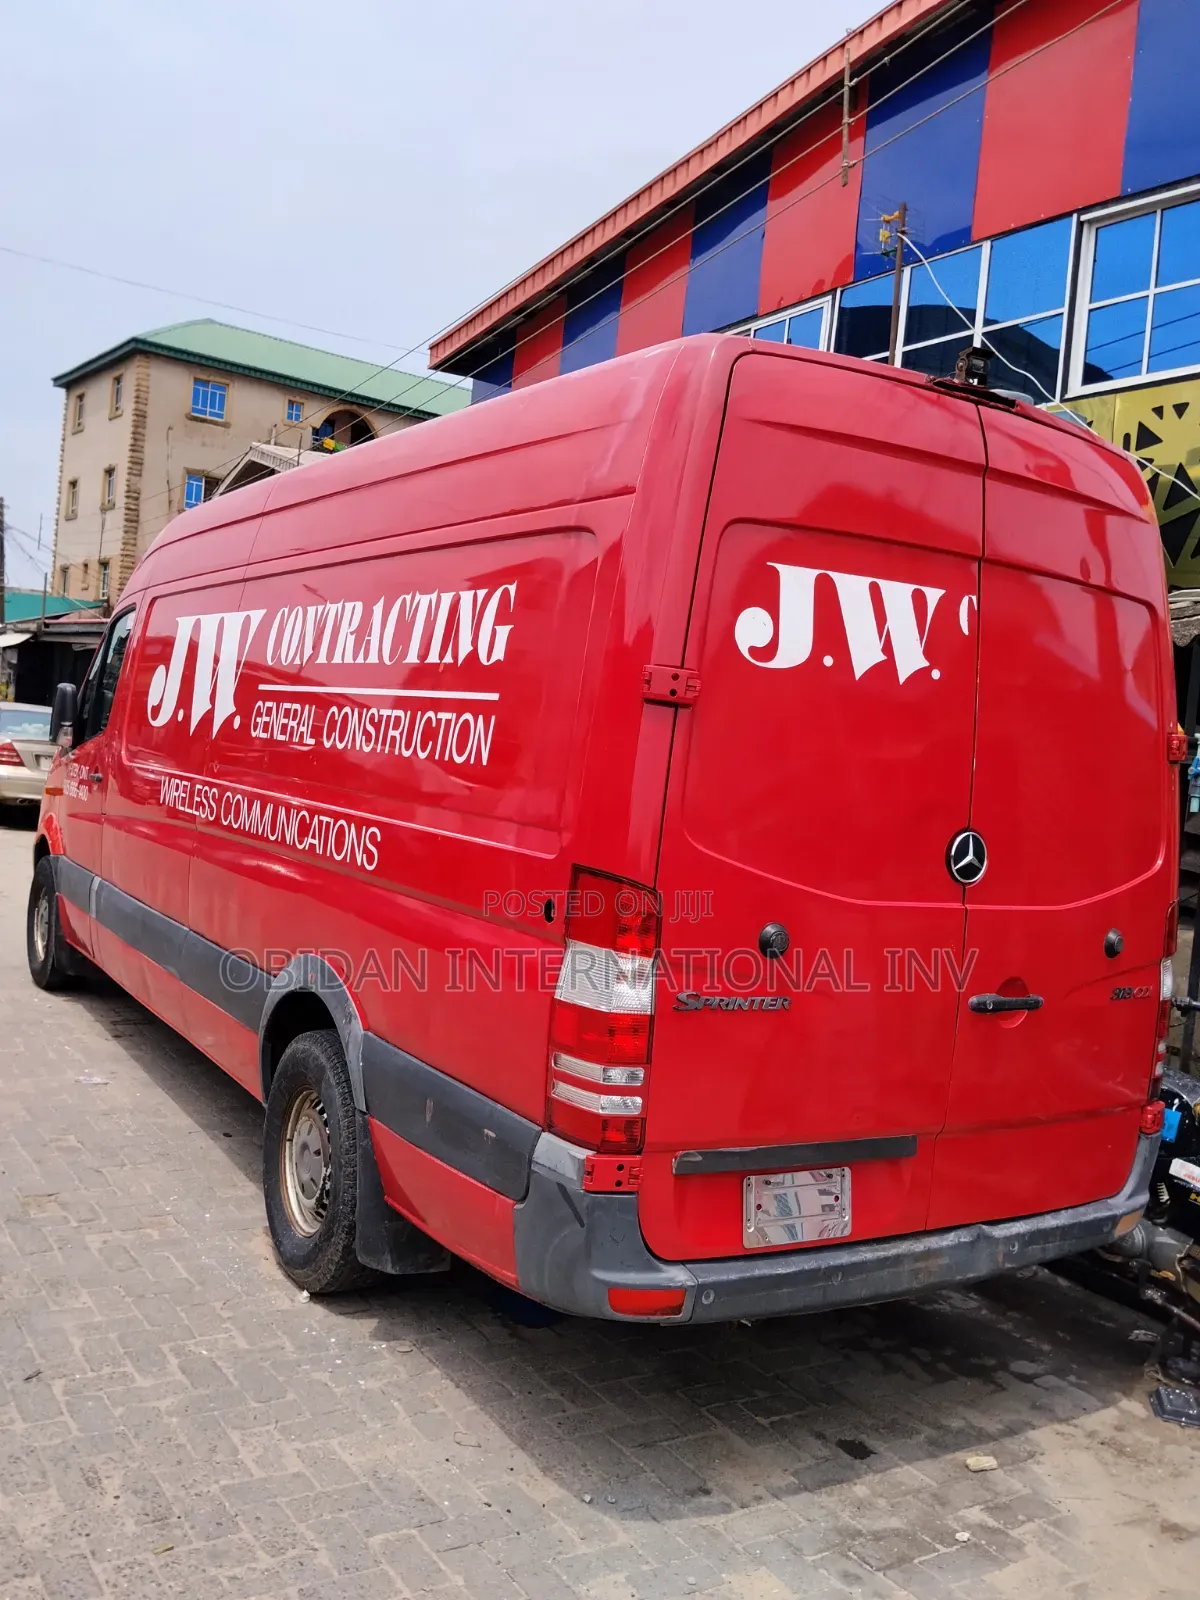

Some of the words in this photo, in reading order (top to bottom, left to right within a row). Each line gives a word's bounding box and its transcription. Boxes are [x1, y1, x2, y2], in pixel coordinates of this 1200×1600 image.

[266, 580, 518, 667] CONTRACTING
[735, 561, 946, 686] J.W.
[250, 700, 315, 746] GENERAL
[322, 704, 496, 767] CONSTRUCTION
[159, 775, 217, 821] WIRELESS
[220, 791, 381, 872] COMMUNICATIONS
